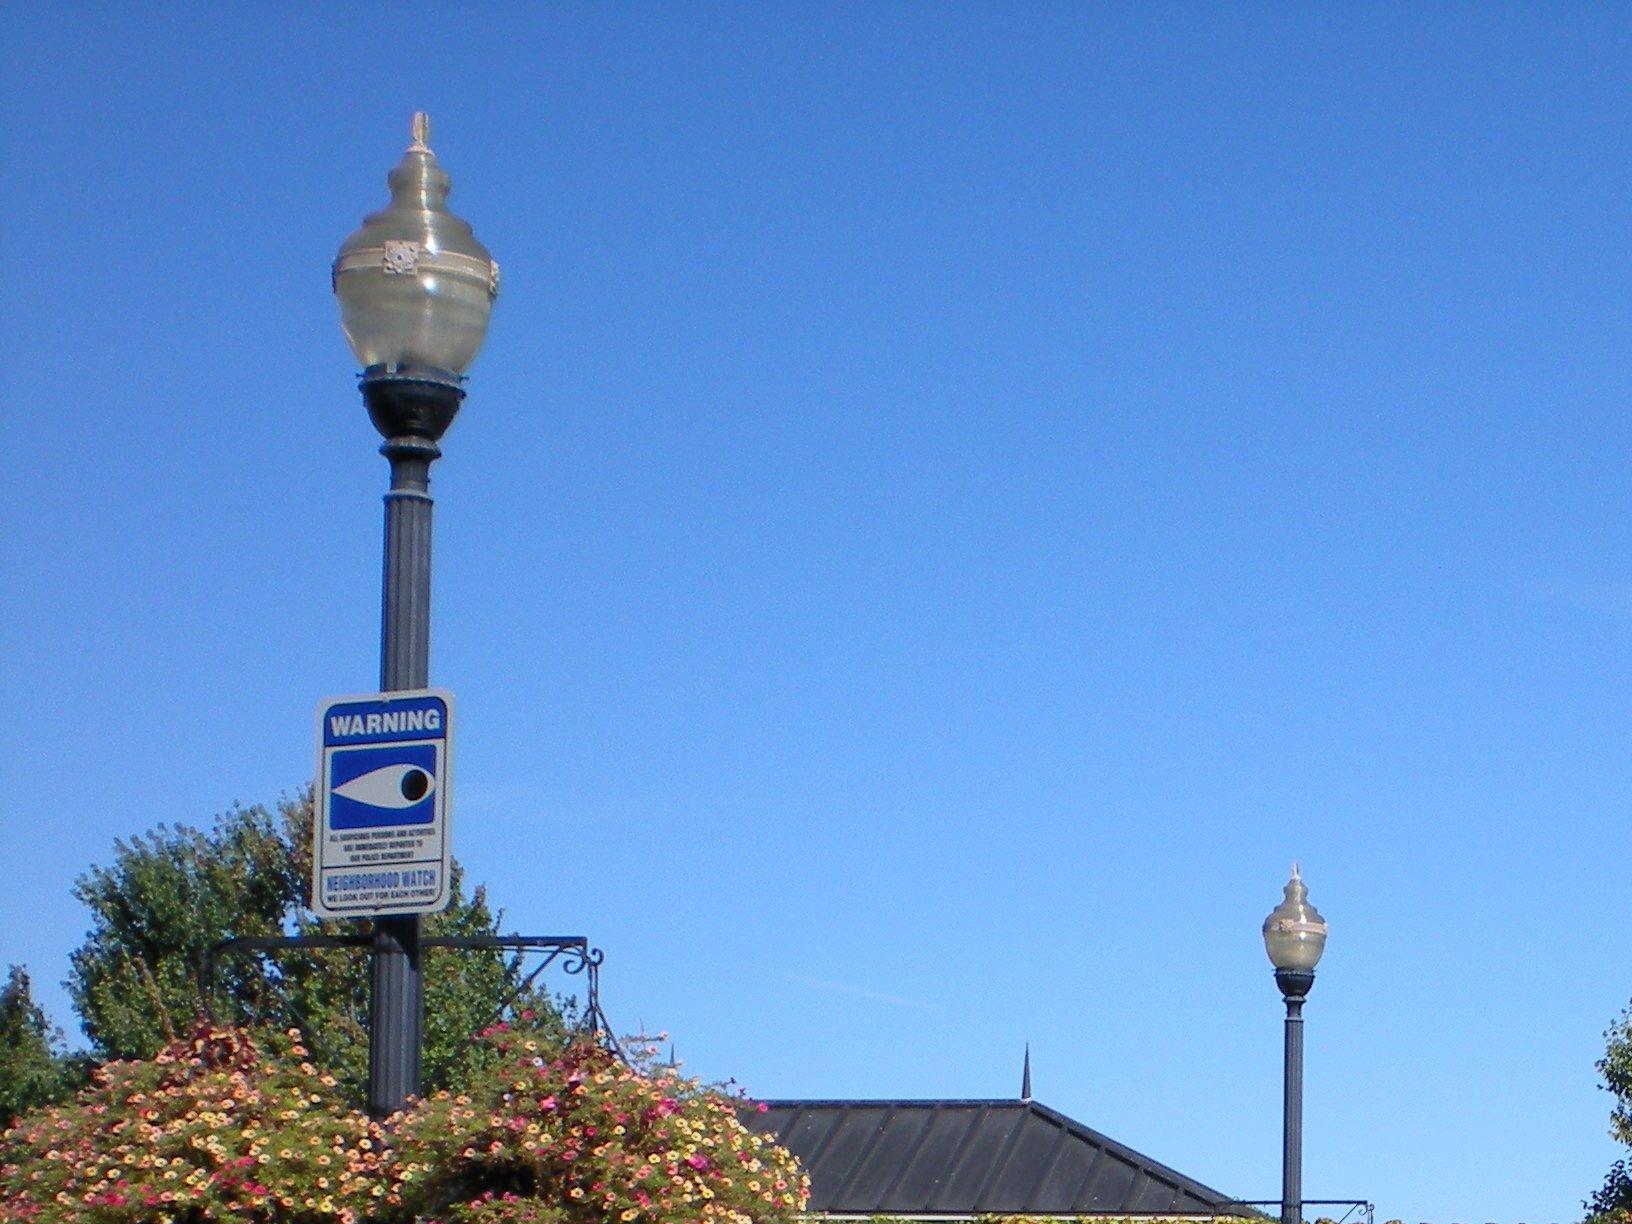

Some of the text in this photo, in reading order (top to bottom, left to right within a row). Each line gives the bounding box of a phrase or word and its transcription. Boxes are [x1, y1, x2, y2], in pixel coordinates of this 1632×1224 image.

[331, 708, 440, 737] WARNING
[327, 870, 436, 892] NEIGHBORHOOD WATCH
